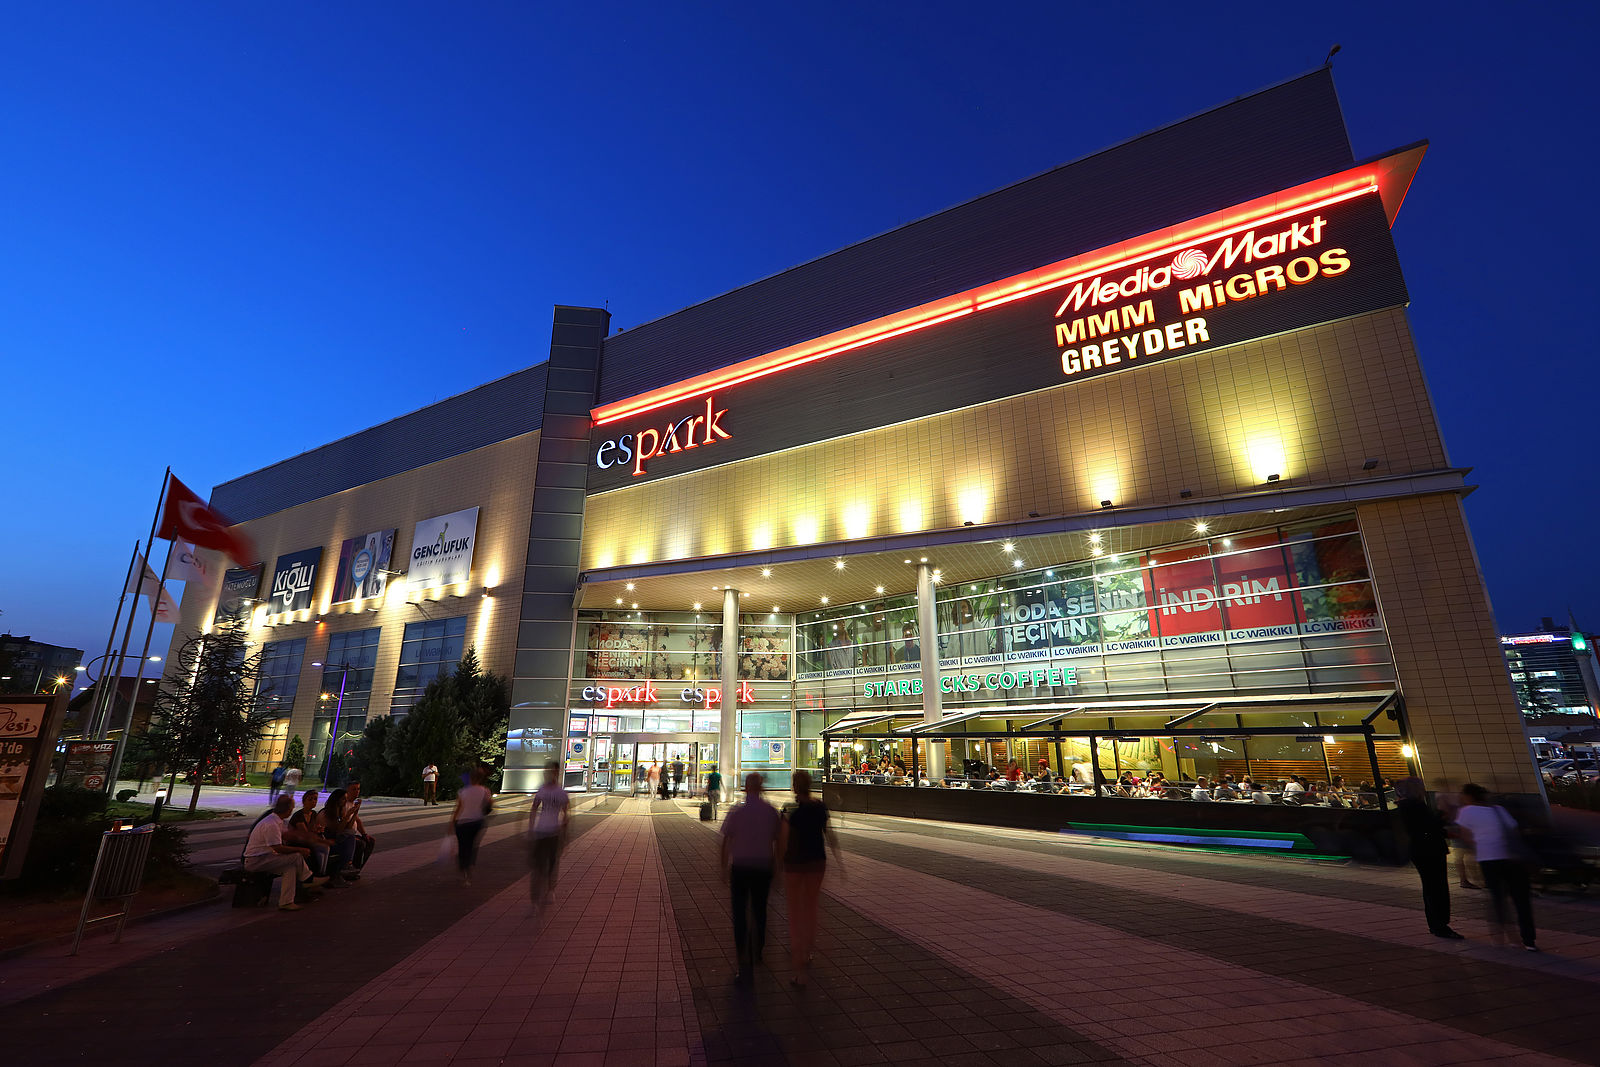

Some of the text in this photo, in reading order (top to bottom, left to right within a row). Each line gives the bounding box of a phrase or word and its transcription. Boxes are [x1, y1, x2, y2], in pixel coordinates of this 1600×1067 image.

[1055, 215, 1327, 318] Media Markt
[1055, 300, 1156, 348] MMM
[1061, 317, 1211, 375] GREYDER
[596, 396, 733, 476] espark
[1002, 600, 1061, 622] MODA
[1231, 631, 1245, 640] LC
[1305, 624, 1321, 633] LC
[1107, 643, 1119, 651] LC
[1165, 637, 1178, 646] LC
[1007, 653, 1017, 661] LC
[1055, 648, 1065, 656] LC
[964, 657, 973, 665] LC
[864, 666, 1078, 698] STARBCKS COFFEE
[582, 680, 755, 710] espark esprk
